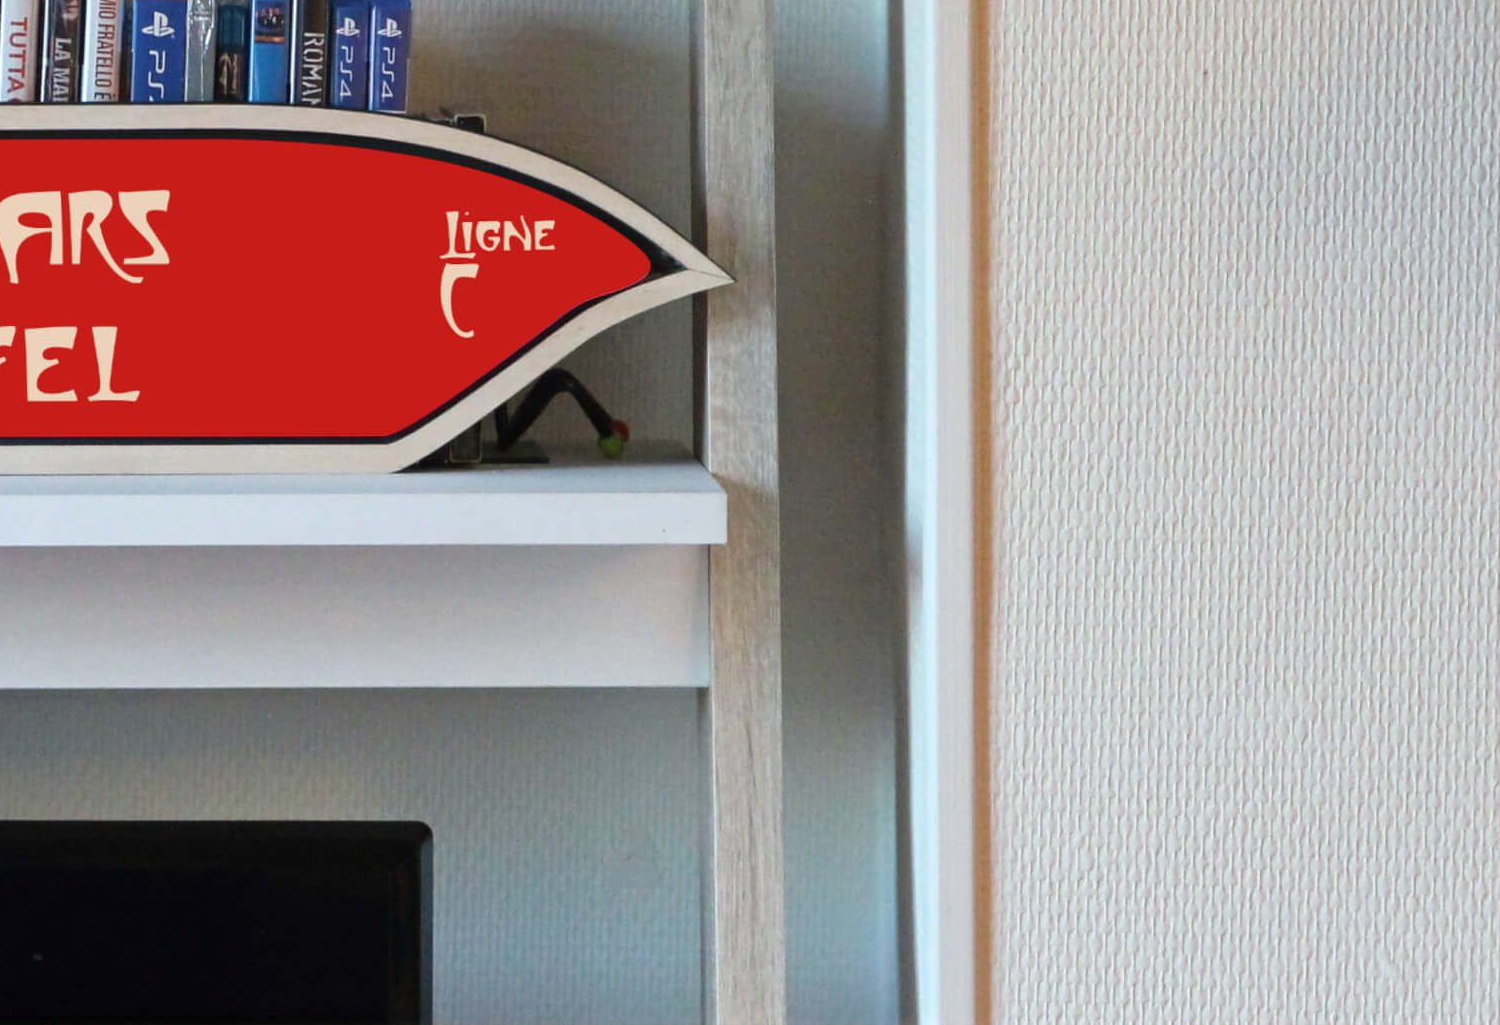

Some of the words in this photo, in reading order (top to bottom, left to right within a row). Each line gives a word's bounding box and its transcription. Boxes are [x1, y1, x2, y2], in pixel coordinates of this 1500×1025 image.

[7, 17, 29, 93] TUTTA
[54, 37, 72, 62] LA
[96, 24, 116, 93] FRATELLO
[148, 50, 166, 102] PS
[340, 45, 354, 100] PS4
[381, 47, 396, 101] PS4
[440, 263, 479, 338] C
